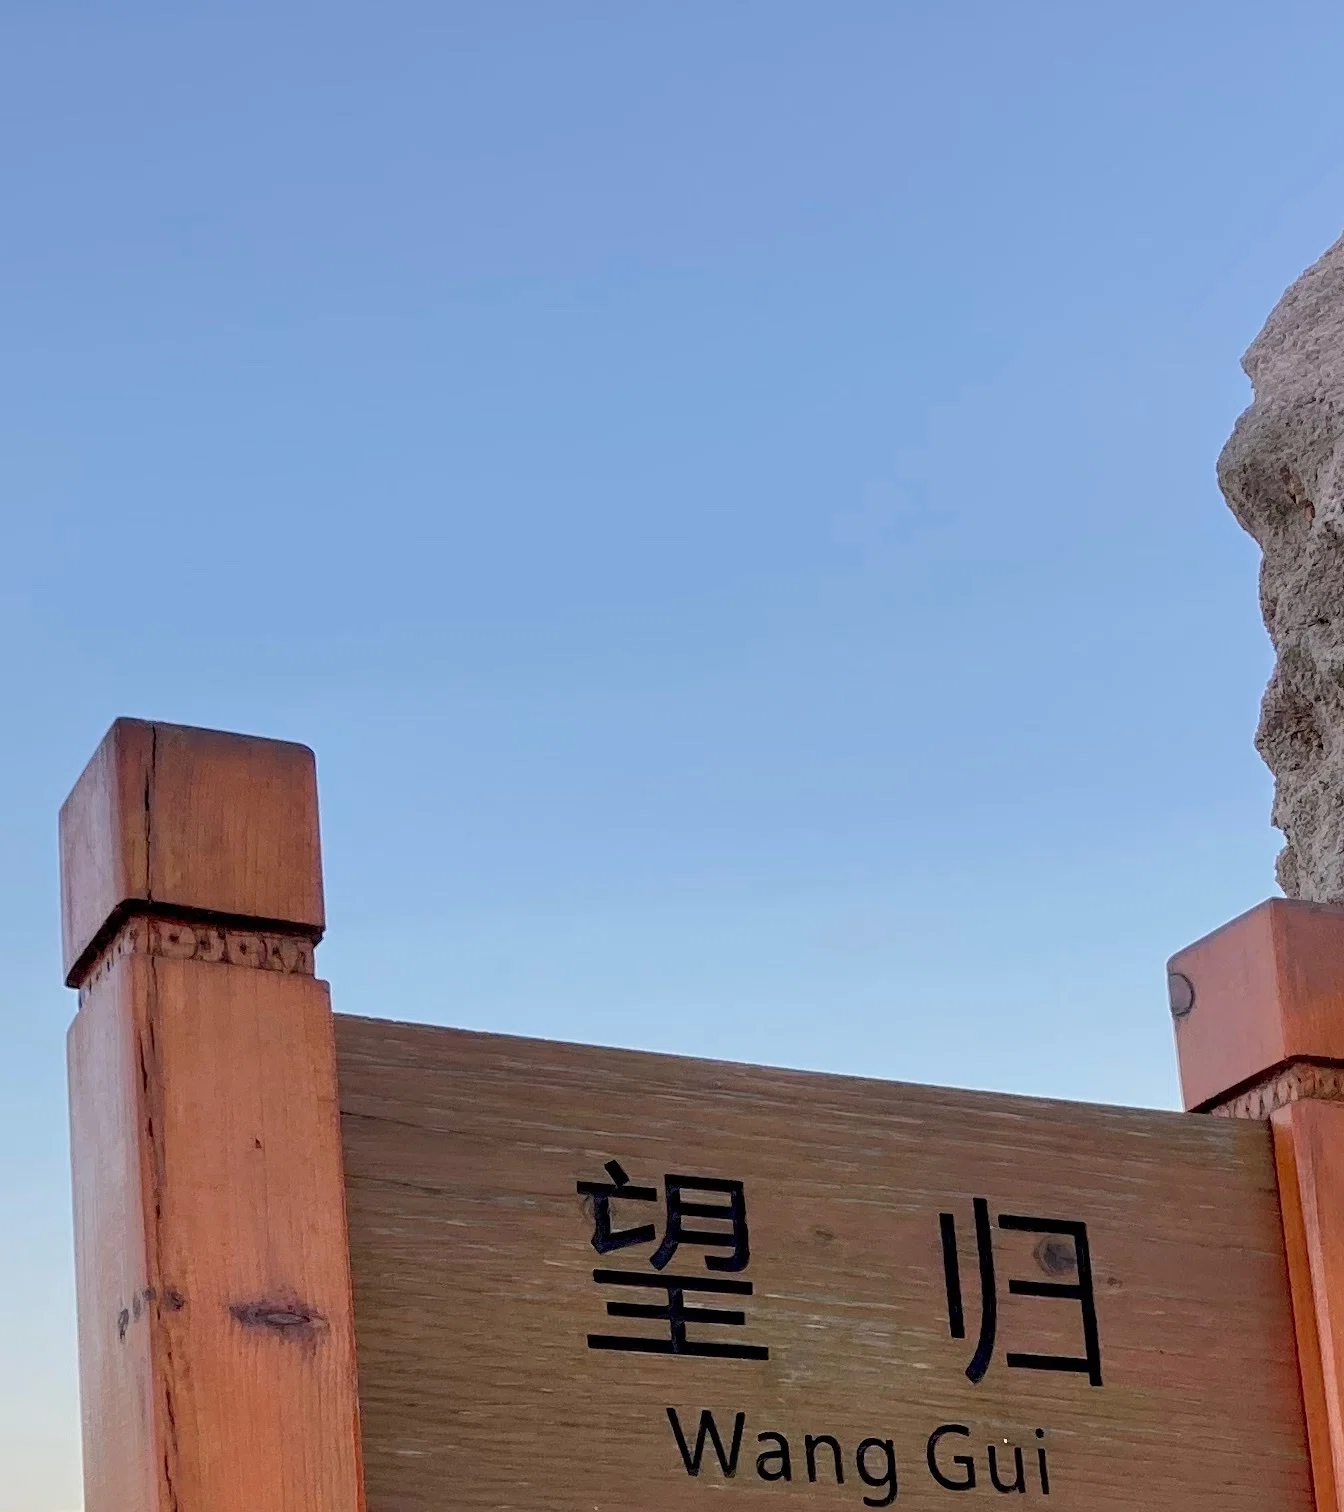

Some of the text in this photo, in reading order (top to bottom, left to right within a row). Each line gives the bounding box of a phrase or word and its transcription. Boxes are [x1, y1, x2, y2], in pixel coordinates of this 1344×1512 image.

[577, 1160, 1103, 1386] 望归
[666, 1407, 1051, 1507] Wang Gui
